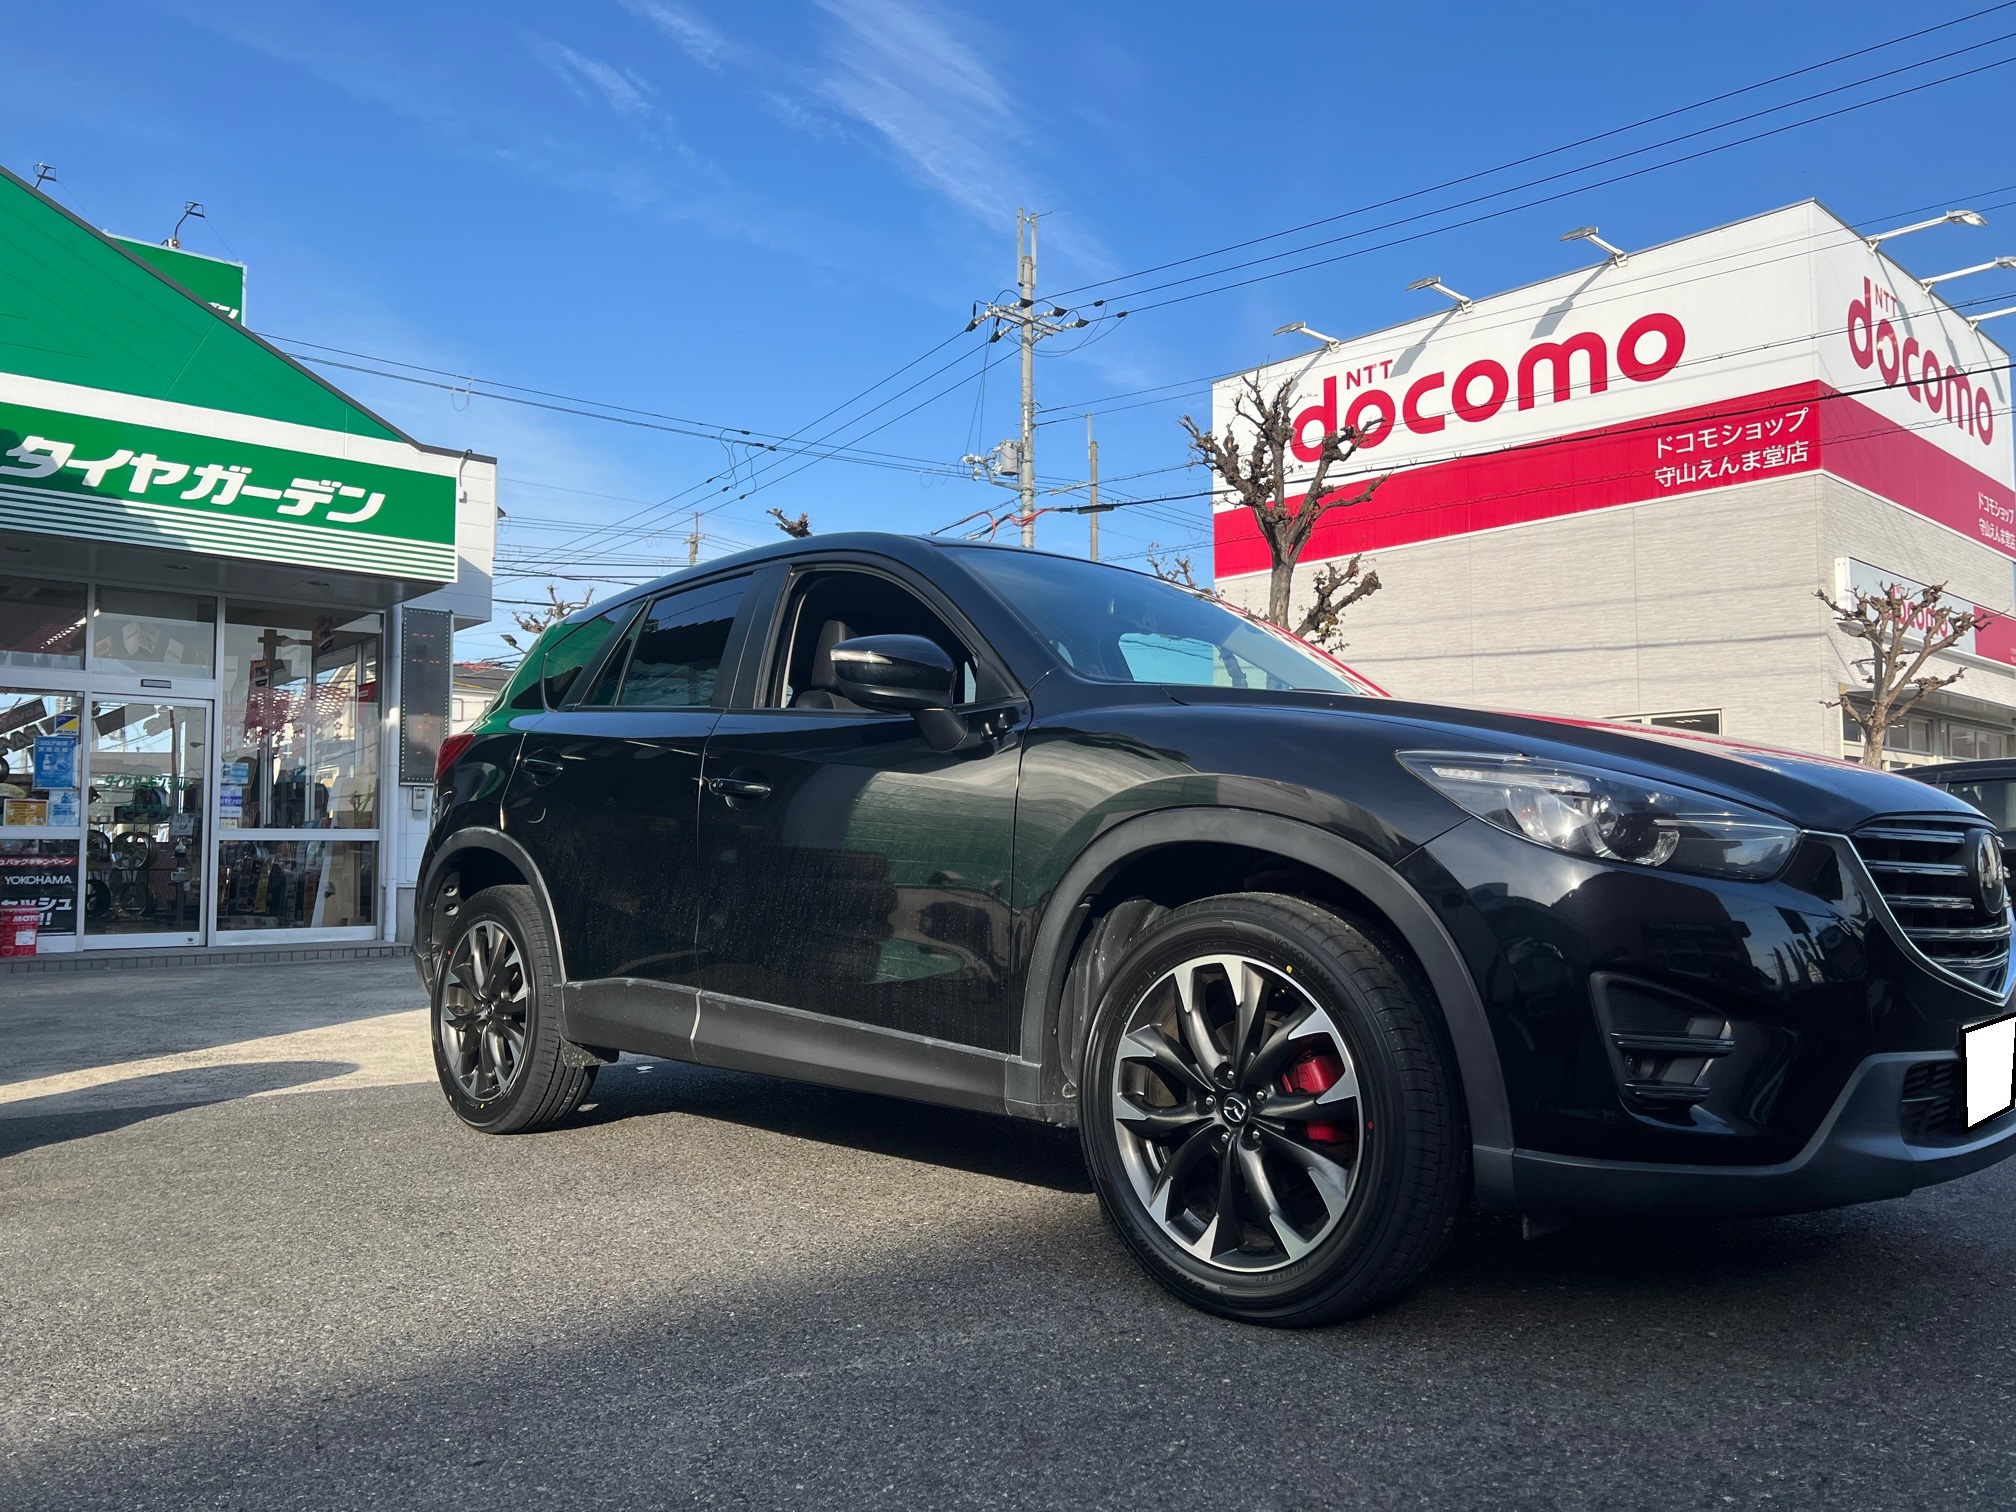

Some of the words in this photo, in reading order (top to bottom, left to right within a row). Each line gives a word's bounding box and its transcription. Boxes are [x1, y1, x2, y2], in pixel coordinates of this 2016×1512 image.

[1875, 283, 1898, 317] NTT
[1345, 359, 1393, 390] NTT
[1847, 275, 1993, 446] docomo
[1290, 313, 1686, 463] docomo
[1656, 406, 1809, 459] ドコモショップ
[0, 435, 386, 523] タイヤガーデン
[1655, 440, 1809, 488] 守山えんま堂店
[4, 875, 72, 885] YOKOHAMA
[1274, 936, 1336, 998] YOKOHAMA
